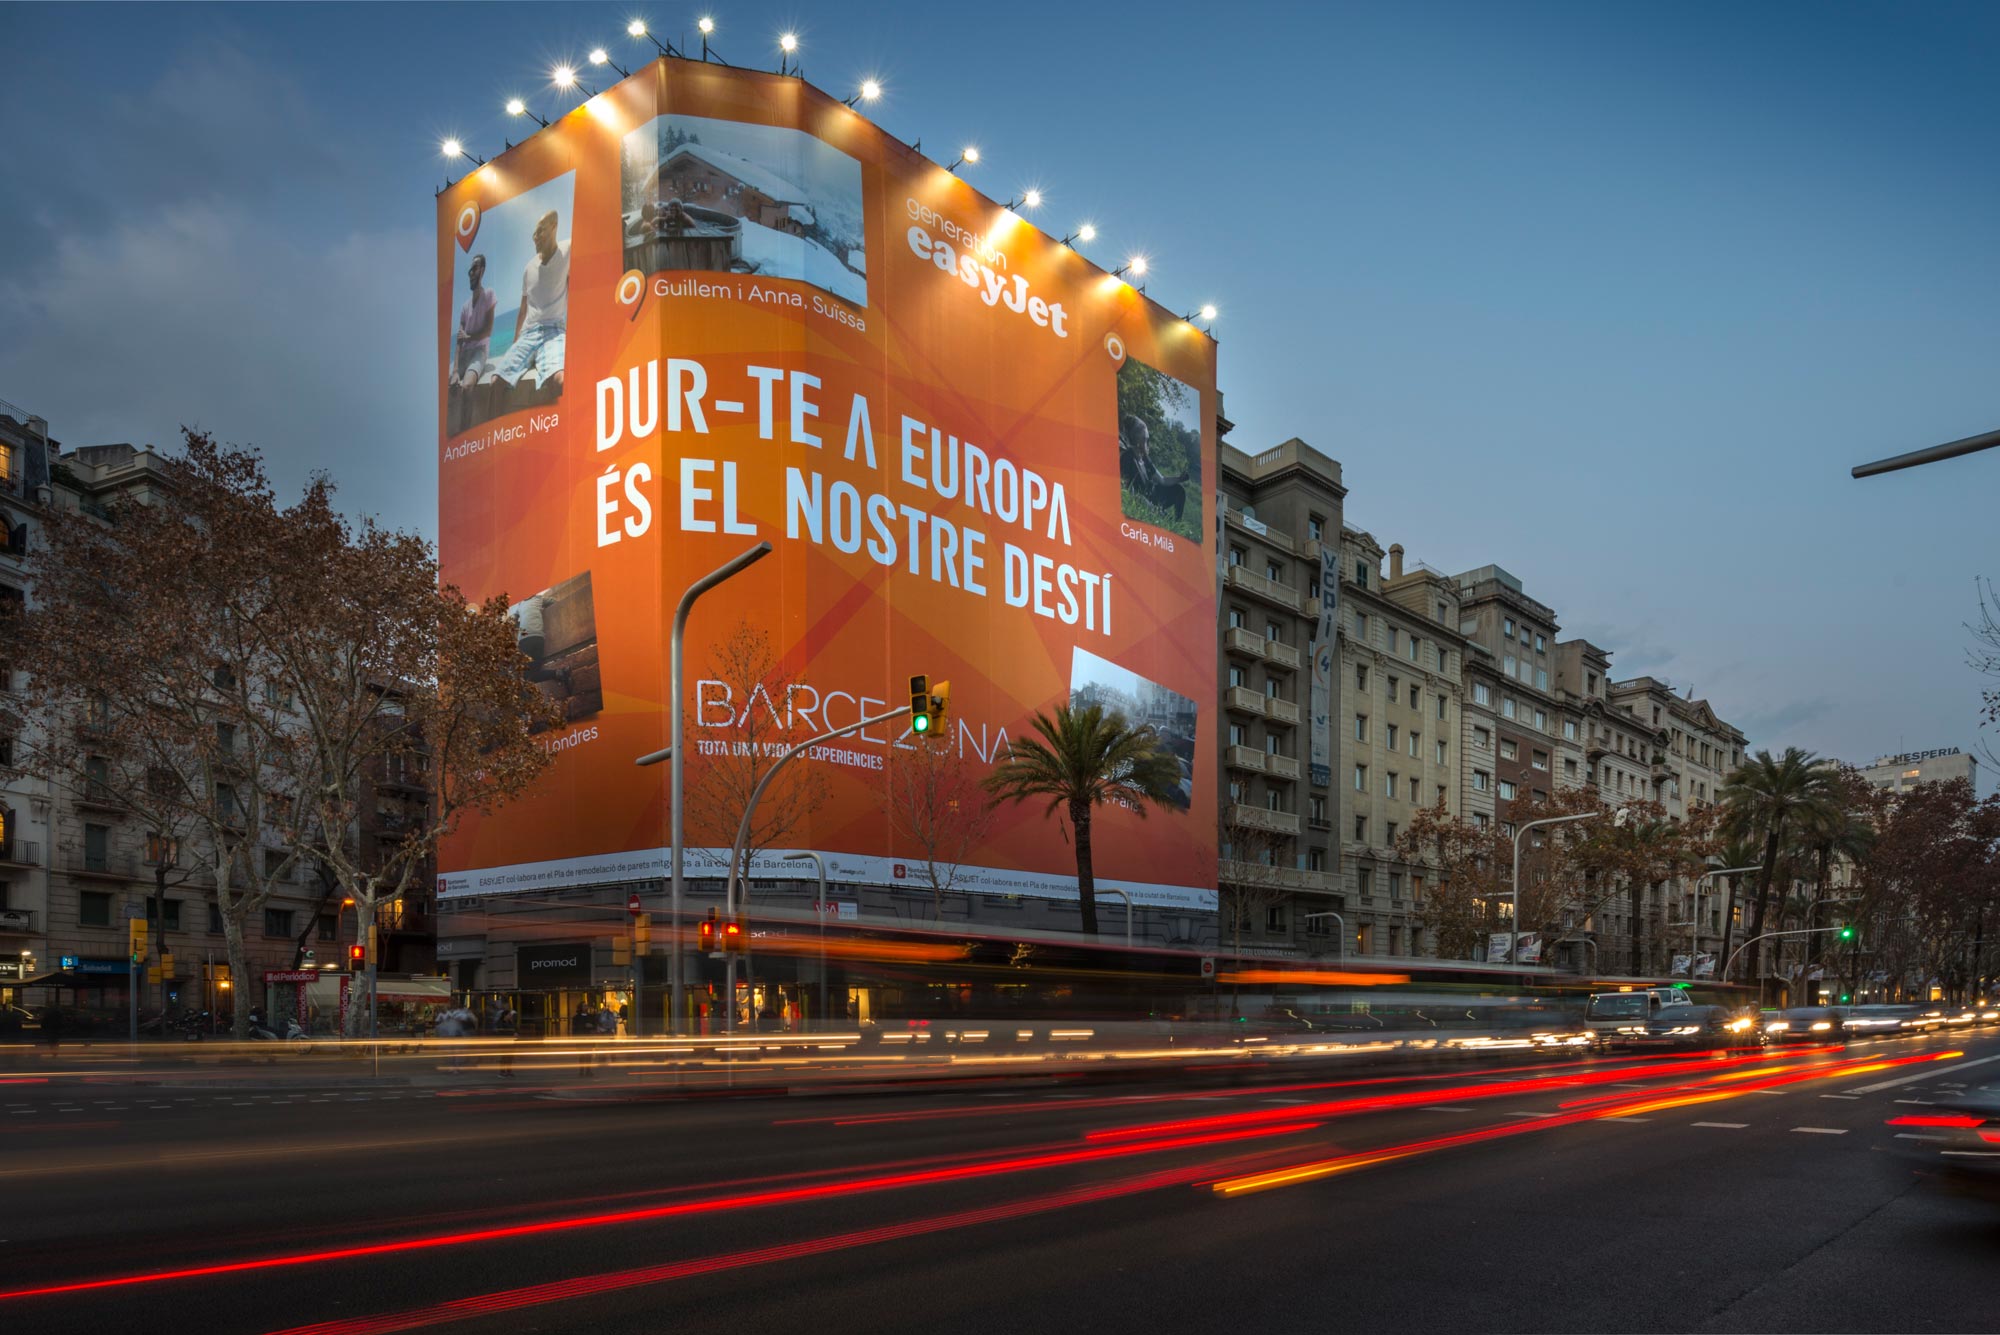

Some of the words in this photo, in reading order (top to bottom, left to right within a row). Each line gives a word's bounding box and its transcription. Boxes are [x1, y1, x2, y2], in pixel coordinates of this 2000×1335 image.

[906, 197, 1007, 270] generation
[907, 225, 1068, 338] easyJet
[654, 278, 731, 299] Guillem
[738, 283, 742, 300] i
[748, 284, 808, 310] Anna,
[813, 295, 866, 333] Suïssa
[443, 438, 485, 463] Andreu
[487, 431, 491, 448] i
[493, 424, 527, 446] Marc,
[529, 413, 559, 434] Niça
[596, 358, 822, 453] DUR-TE
[843, 392, 878, 470] A
[901, 414, 1072, 546] EUROPA
[597, 461, 652, 548] ÉS
[680, 457, 757, 536] EL
[786, 466, 987, 597] NOSTRE
[1004, 542, 1113, 637] DESTÍ
[1120, 522, 1152, 547] Carla,
[1153, 533, 1174, 553] Milà
[545, 725, 599, 753] Londres
[696, 740, 729, 756] TOTA
[732, 741, 760, 757] UNA
[762, 742, 793, 758] VIDA
[1893, 746, 1961, 763] HESPERIA
[554, 868, 565, 878] Pla
[565, 867, 575, 877] de
[575, 864, 616, 876] remodelació
[617, 862, 626, 872] de
[627, 863, 650, 874] parets
[703, 859, 713, 868] la
[749, 859, 761, 869] de
[763, 860, 813, 869] Barcelona
[815, 904, 837, 913] VSA
[280, 971, 316, 981] Periódico
[531, 956, 577, 970] promod
